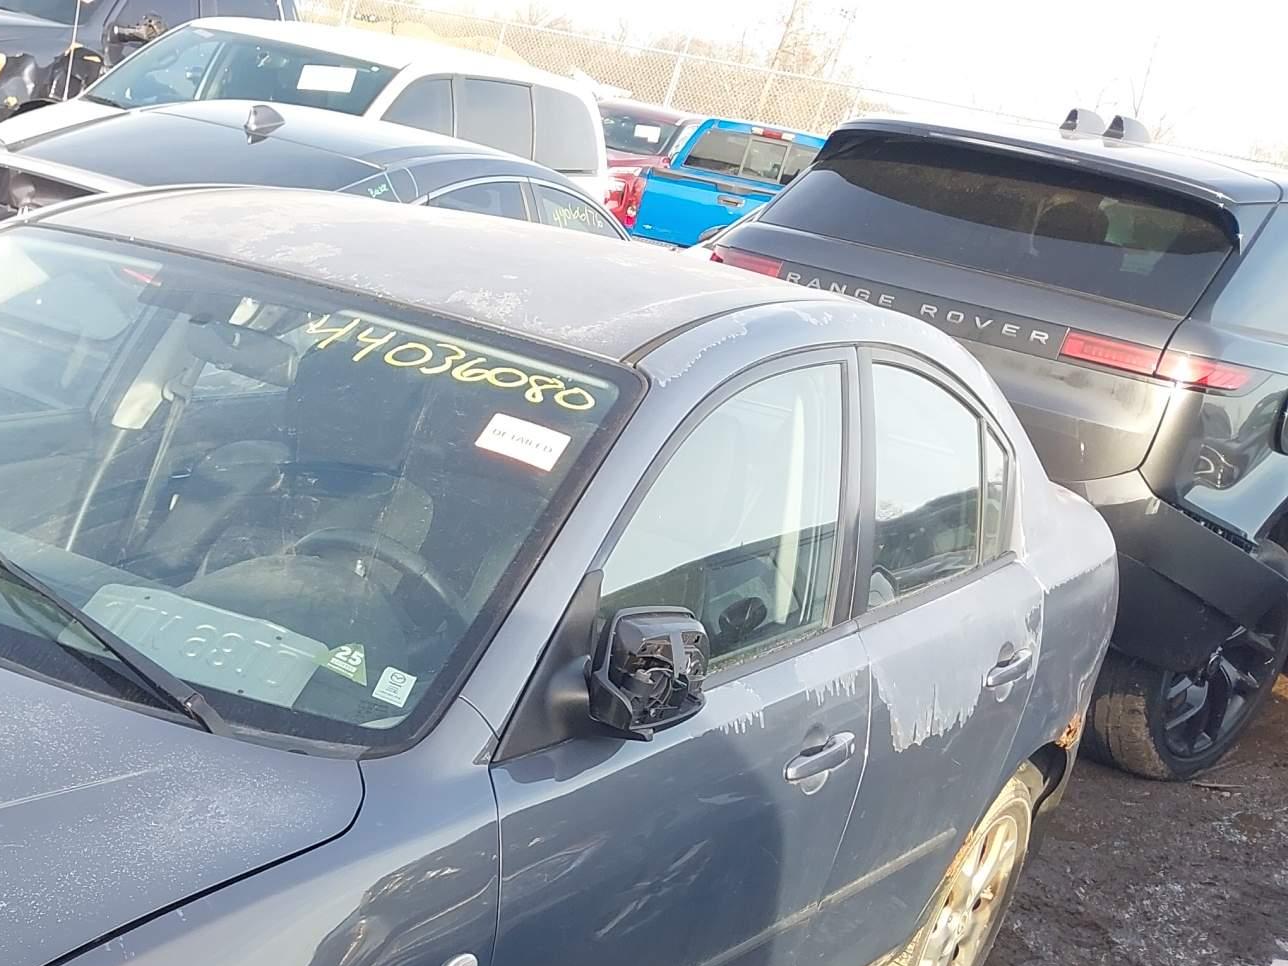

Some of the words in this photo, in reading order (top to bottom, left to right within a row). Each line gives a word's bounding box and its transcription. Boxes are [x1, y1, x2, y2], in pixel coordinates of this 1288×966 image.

[786, 271, 896, 308] RANGE
[919, 303, 1050, 345] ROVER
[305, 314, 596, 411] 44036080
[334, 645, 365, 666] 25
